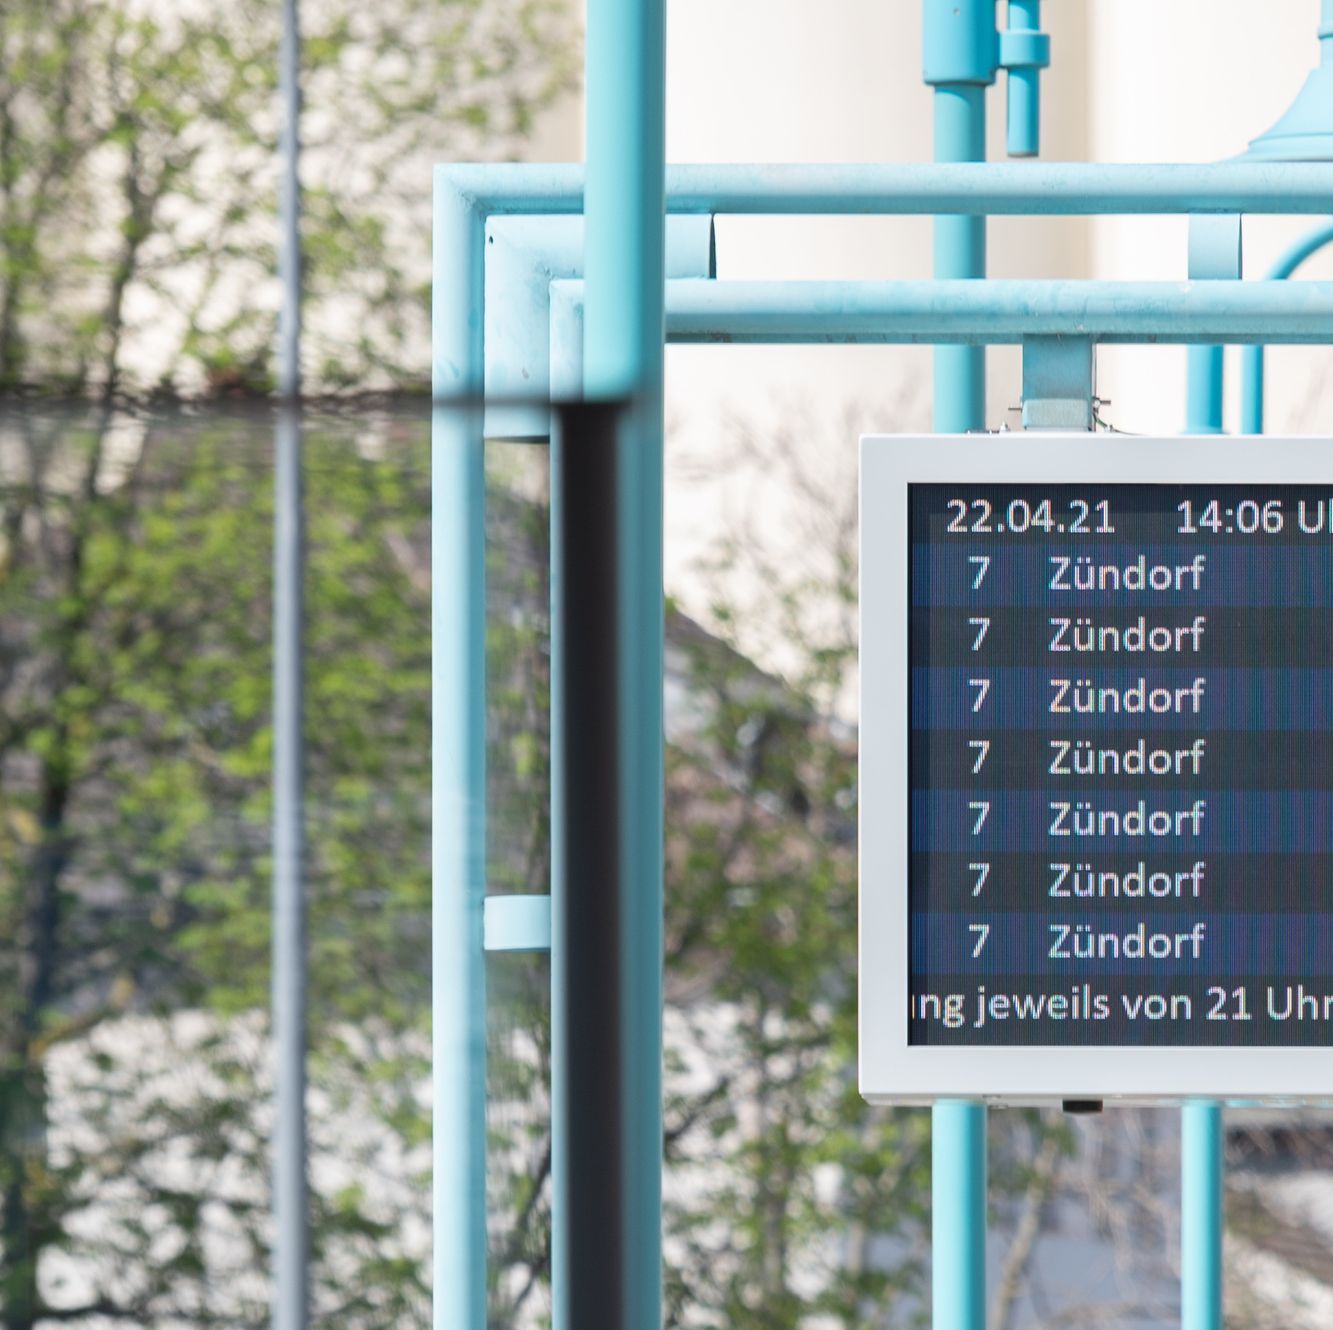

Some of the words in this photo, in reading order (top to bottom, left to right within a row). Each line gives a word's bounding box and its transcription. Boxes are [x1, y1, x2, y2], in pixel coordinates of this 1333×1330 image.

[946, 499, 1116, 534] 22.04.21
[1178, 500, 1284, 534] 14:06
[969, 555, 991, 589] 7
[1050, 554, 1206, 591] Zündorf
[968, 617, 991, 651] 7
[1049, 615, 1206, 652] Zündorf
[968, 679, 991, 713] 7
[1049, 677, 1206, 714] Zündorf
[968, 740, 991, 774] 7
[1049, 738, 1206, 775] Zündorf
[968, 802, 991, 835] 7
[1049, 800, 1206, 836] Zündorf
[968, 863, 991, 897] 7
[1049, 861, 1206, 898] Zündorf
[968, 924, 991, 958] 7
[1049, 922, 1206, 959] Zündorf
[974, 984, 1111, 1028] jeweils
[1121, 993, 1192, 1020] von
[1207, 986, 1252, 1021] 21
